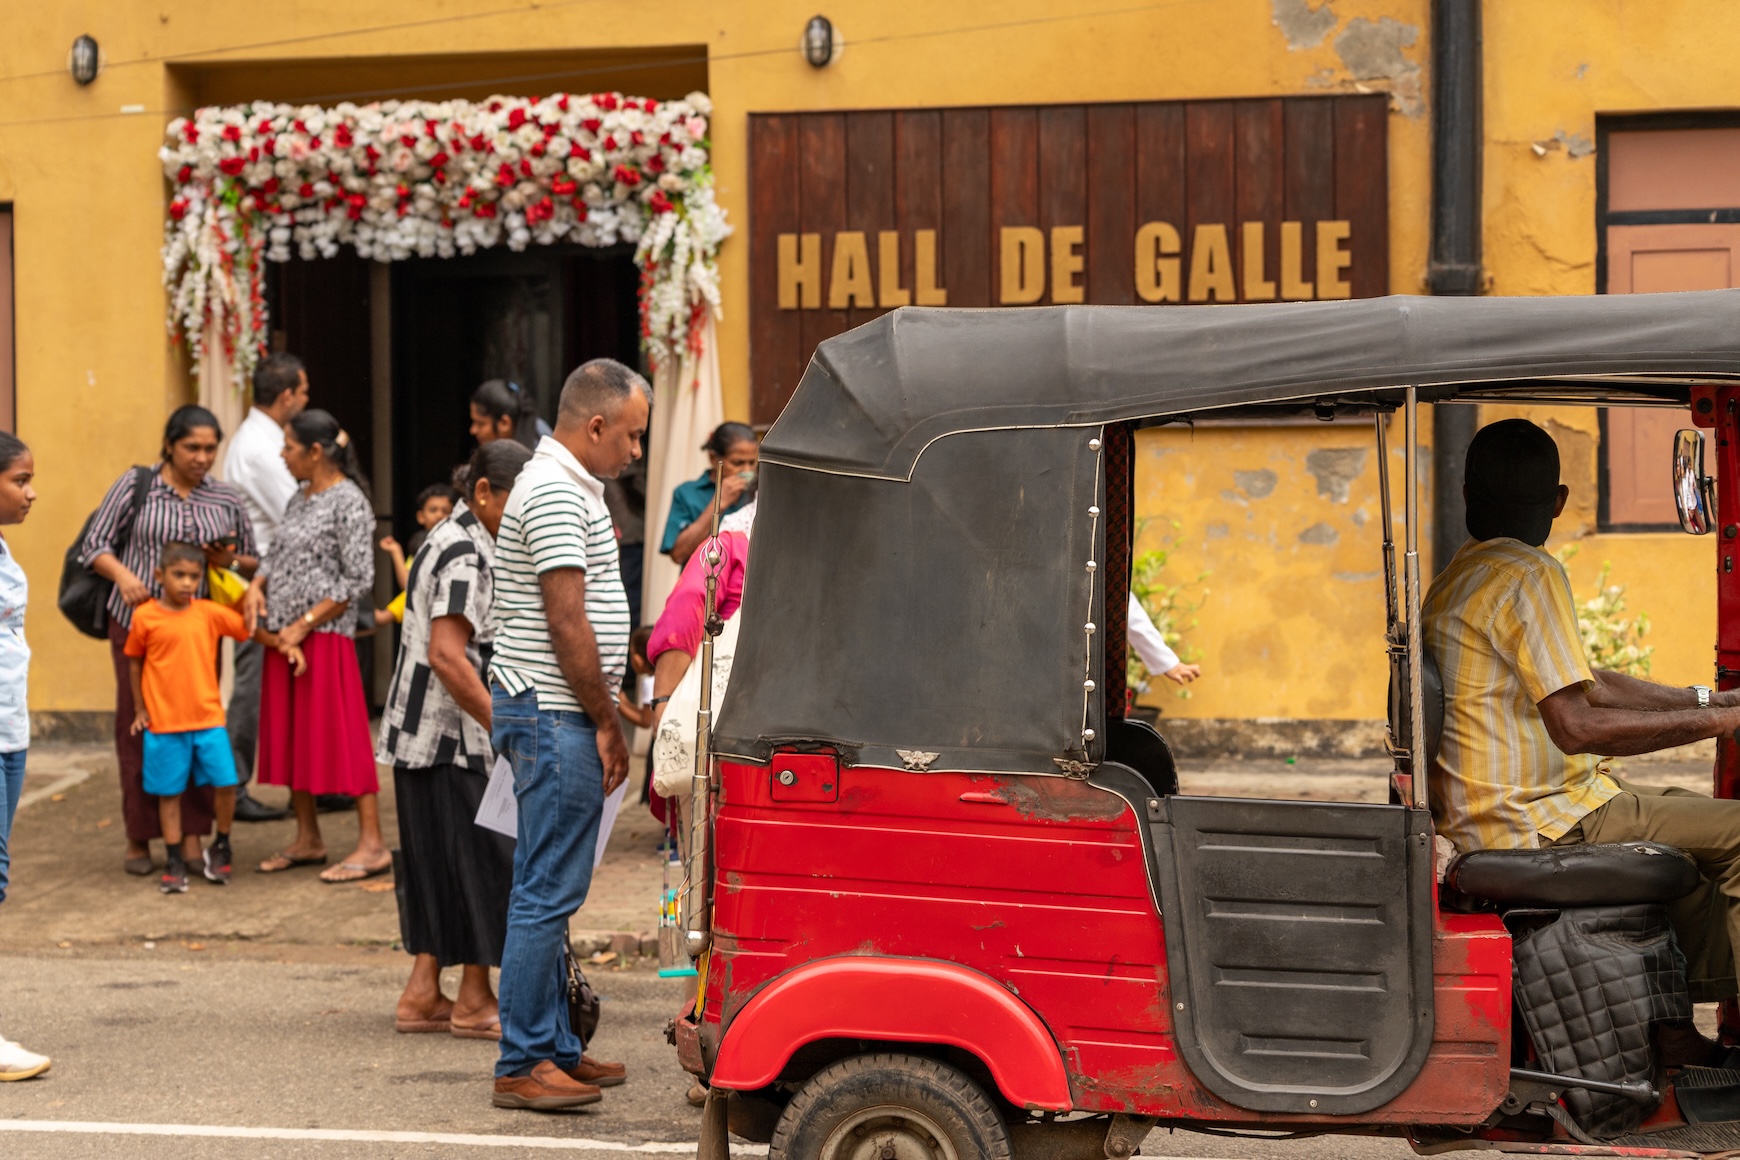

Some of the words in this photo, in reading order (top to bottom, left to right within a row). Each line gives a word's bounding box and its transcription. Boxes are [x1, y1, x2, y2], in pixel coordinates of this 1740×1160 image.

[779, 230, 947, 309] HALL
[1000, 225, 1084, 304] DE
[1135, 220, 1351, 302] GALLE
